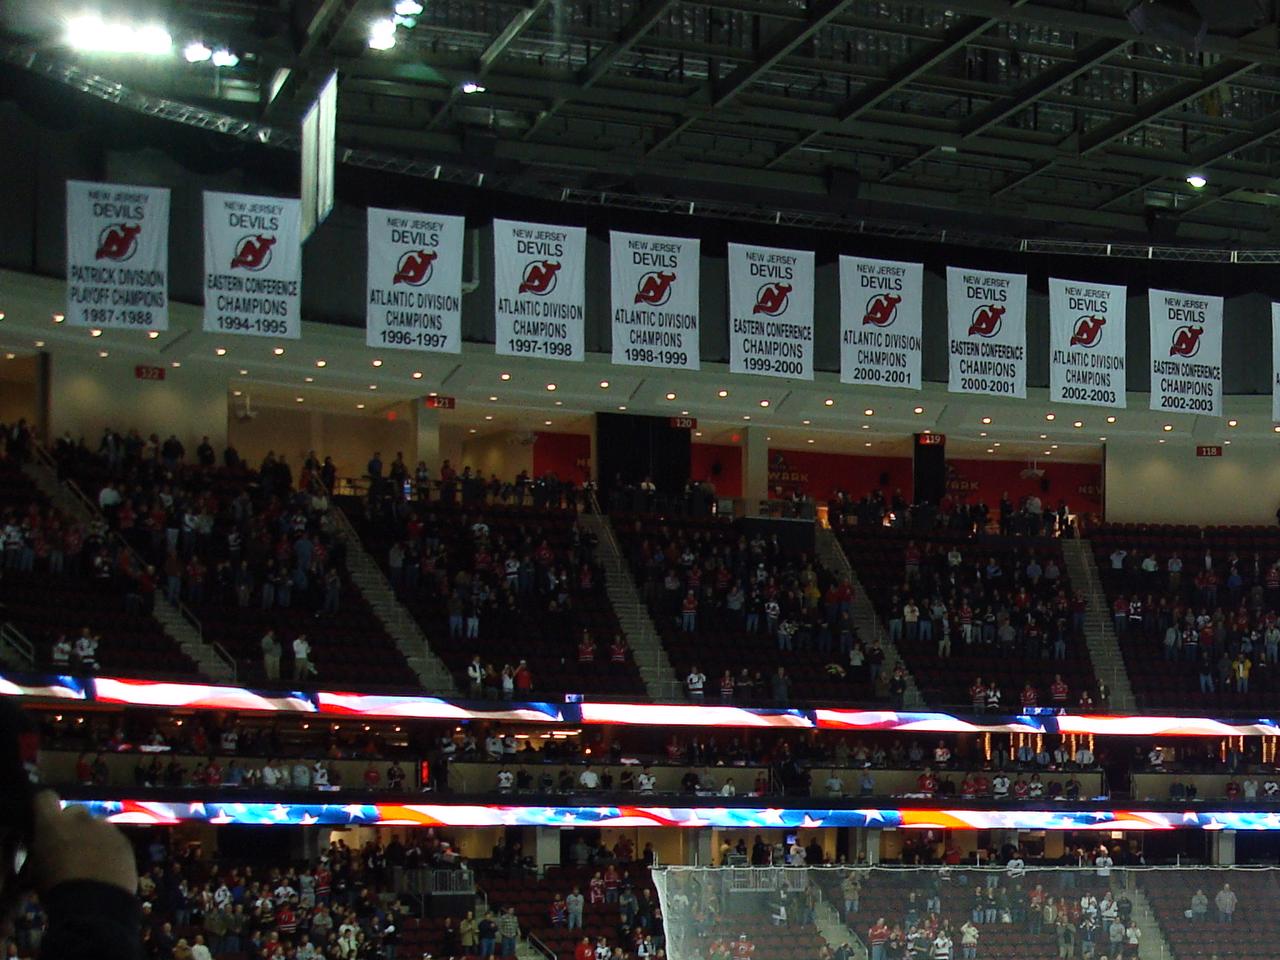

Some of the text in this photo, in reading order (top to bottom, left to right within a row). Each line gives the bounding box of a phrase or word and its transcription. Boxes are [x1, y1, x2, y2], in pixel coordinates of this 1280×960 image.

[89, 192, 149, 202] NEW JERSEY
[93, 204, 144, 219] DEVILS
[224, 201, 284, 214] NEW JERSEY
[229, 213, 279, 230] DEVILS
[387, 218, 444, 231] NEW JERSEY
[391, 229, 439, 247] DEVILS
[513, 228, 567, 241] NEW JERSEY
[517, 240, 563, 256] DEVILS
[628, 240, 682, 253] NEW JERSEY
[632, 251, 678, 268] DEVILS
[746, 252, 797, 264] NEW JERSEY
[72, 268, 164, 286] PATRICK DIVISION
[750, 264, 793, 279] DEVILS
[857, 264, 906, 276] NEW JERSEY
[208, 274, 297, 296] EASTERN CONFERENCE
[861, 275, 902, 290] DEVILS
[963, 275, 1010, 287] NEW JERSEY
[72, 289, 163, 307] PLAYOFF CHAMPIONS
[370, 289, 459, 310] ATLANTIC DIVISION
[967, 286, 1007, 301] DEVILS
[1065, 287, 1110, 299] NEW JERSEY
[217, 297, 287, 315] CHAMPIONS
[498, 298, 583, 320] ATLANTIC DIVISION
[1069, 298, 1107, 313] DEVILS
[1165, 298, 1208, 310] NEW JERSEY
[81, 308, 152, 325] 1987-1988
[386, 310, 442, 330] CHAMPIONS
[615, 309, 696, 329] ATLANTIC DIVISION
[1168, 308, 1205, 323] DEVILS
[217, 316, 287, 333] 1994-1995
[513, 320, 567, 338] CHAMPIONS
[734, 319, 812, 341] EASTERN CONFERENCE
[380, 330, 447, 348] 1996-1997
[630, 330, 682, 347] CHAMPIONS
[844, 330, 920, 350] ATLANTIC DIVISION
[508, 339, 572, 356] 1997-1998
[743, 339, 803, 358] CHAMPIONS
[951, 340, 1023, 360] EASTERN CONFERENCE
[625, 348, 687, 365] 1998-1999
[858, 350, 906, 368] CHAMPIONS
[1054, 350, 1124, 370] ATLANTIC DIVISION
[743, 358, 803, 374] 1999-2000
[960, 359, 1016, 377] CHAMPIONS
[1153, 359, 1220, 380] EASTERN CONFERENCE
[854, 368, 911, 384] 2000-2001
[1066, 370, 1111, 387] CHAMPIONS
[961, 378, 1015, 394] 2000-2001
[1160, 378, 1213, 397] CHAMPIONS
[1062, 387, 1116, 403] 2002-2003
[1161, 396, 1213, 412] 2002-2003
[676, 418, 692, 428] 120
[926, 434, 941, 443] 119
[1202, 447, 1217, 456] 118
